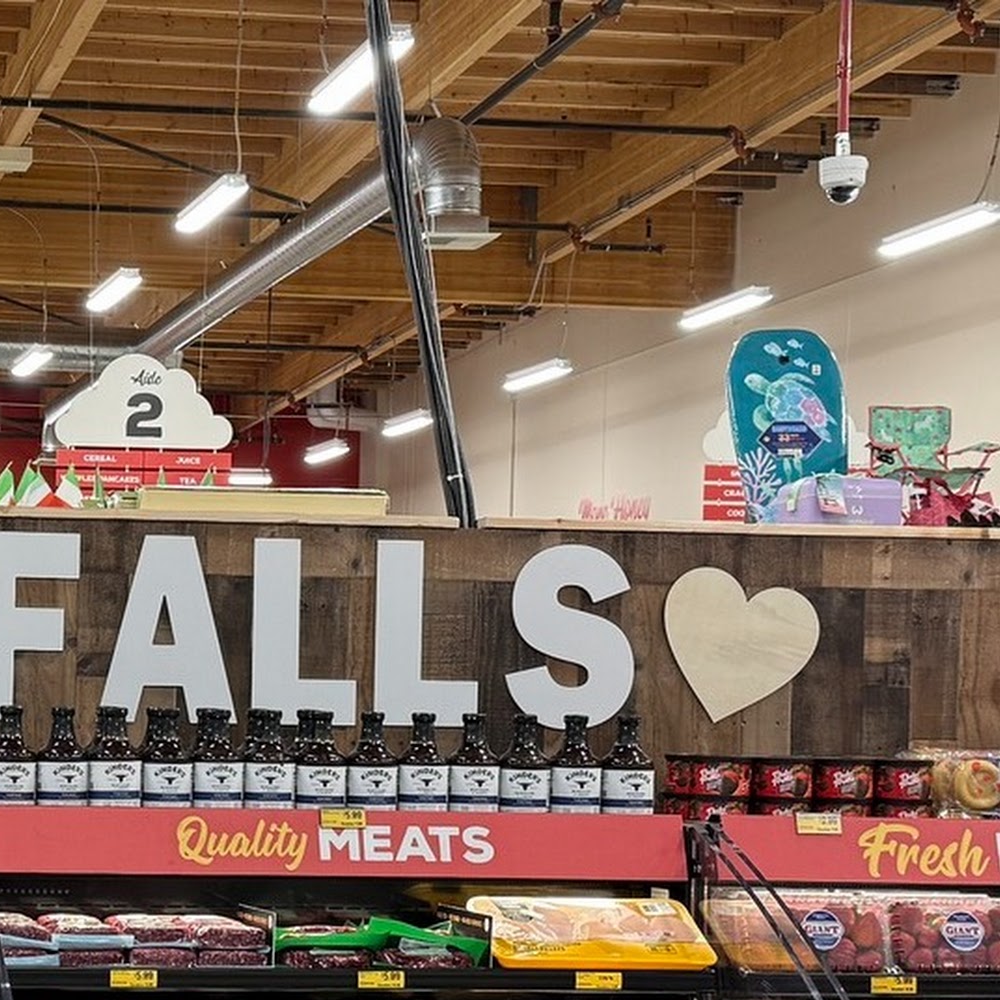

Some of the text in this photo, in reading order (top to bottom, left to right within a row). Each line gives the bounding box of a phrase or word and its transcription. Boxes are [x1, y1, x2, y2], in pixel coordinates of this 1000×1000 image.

[130, 369, 162, 386] Aisle
[125, 392, 163, 438] 2
[83, 454, 117, 462] CEREAL
[175, 457, 201, 465] JUICE
[176, 815, 495, 872] Quality MEATS
[858, 822, 991, 878] Fresh
